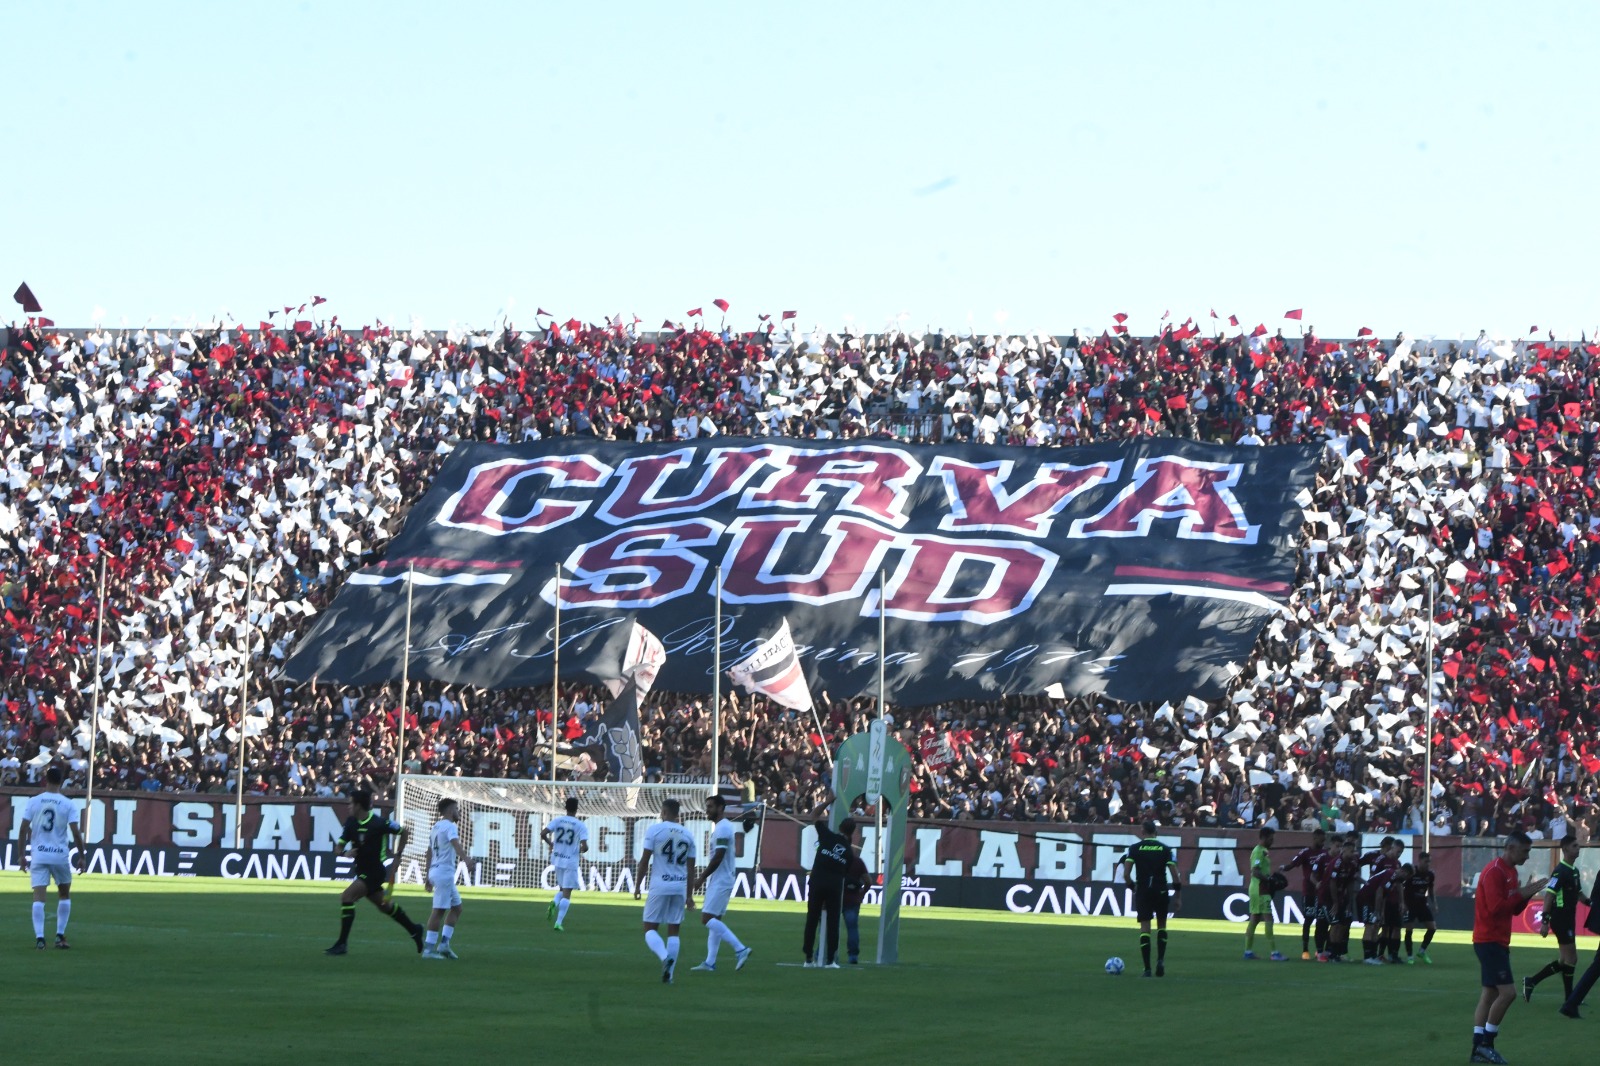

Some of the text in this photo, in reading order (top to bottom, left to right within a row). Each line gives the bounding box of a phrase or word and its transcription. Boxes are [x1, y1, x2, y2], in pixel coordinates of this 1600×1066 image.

[435, 444, 1261, 546] CURVA
[540, 514, 1060, 626] SUD
[41, 809, 55, 832] 3
[556, 826, 575, 846] 23
[661, 837, 689, 866] 42
[220, 852, 356, 882] CANALE
